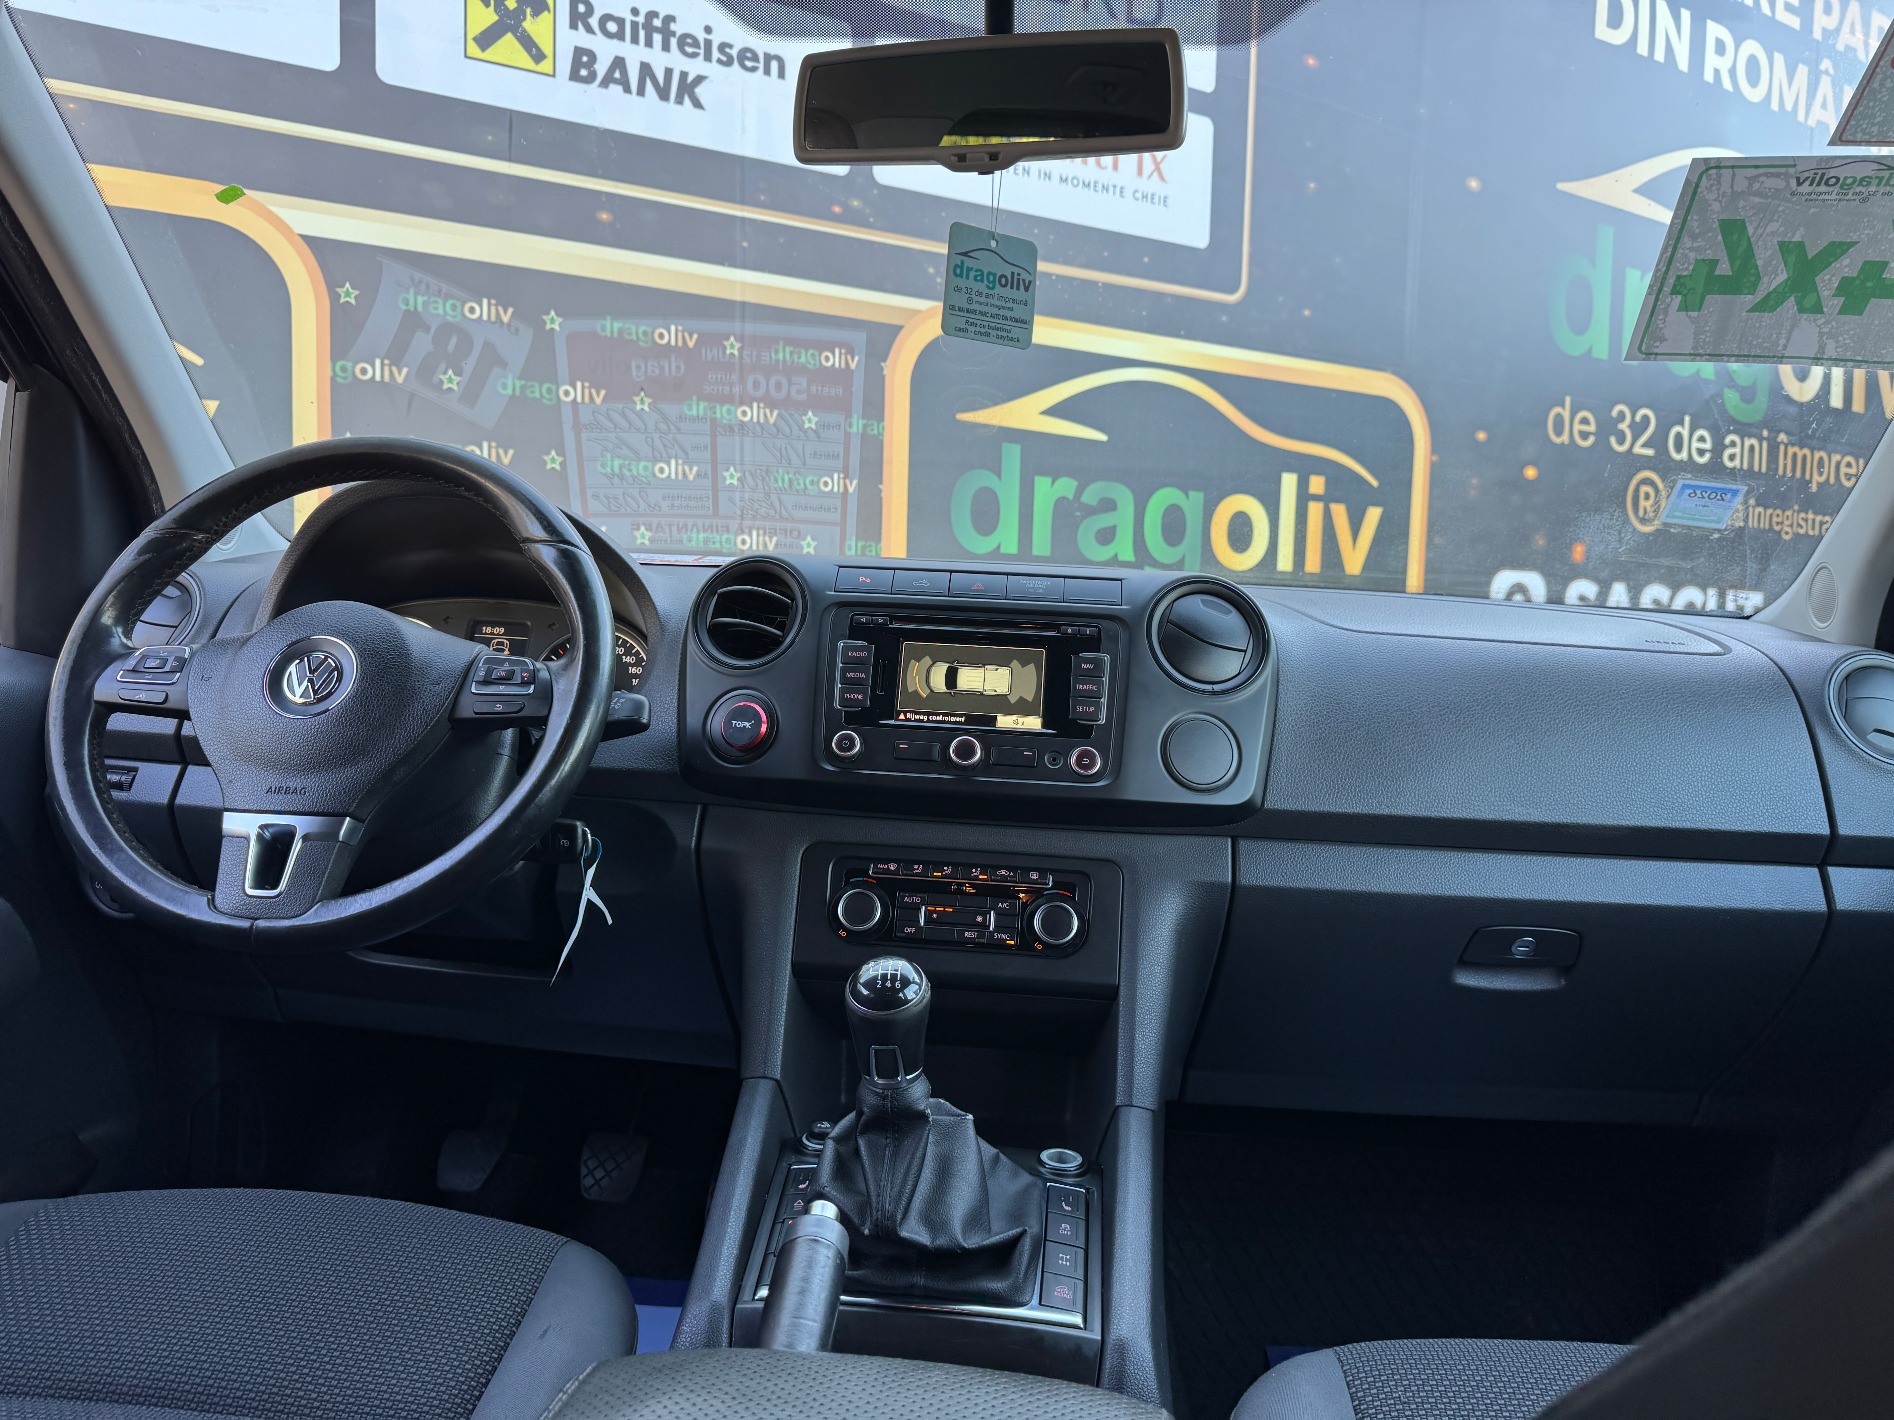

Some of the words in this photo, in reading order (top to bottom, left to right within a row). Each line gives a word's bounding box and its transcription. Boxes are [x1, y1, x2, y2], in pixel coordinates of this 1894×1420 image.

[568, 0, 787, 80] Raiffeisen
[1594, 0, 1690, 73] DIN
[568, 46, 706, 111] BANK
[1038, 168, 1052, 182] IN
[1059, 173, 1126, 199] MOMENTE
[1132, 188, 1170, 208] CHEIE
[952, 260, 1032, 292] dragoliv
[954, 285, 963, 293] de
[964, 287, 973, 296] 32
[975, 289, 983, 297] de
[398, 288, 514, 323] dragoliv
[596, 316, 699, 349] dragoliv
[954, 326, 969, 334] cash
[331, 357, 409, 384] goliv
[771, 341, 860, 371] dragoliv
[497, 373, 607, 405] dragoliv
[683, 395, 779, 425] dragoliv
[1547, 395, 1596, 448] de
[1609, 403, 1657, 457] 32
[1667, 414, 1713, 464] de
[1722, 428, 1769, 474] ani
[596, 451, 699, 482] dragoliv
[771, 468, 858, 494] dragoliv
[951, 442, 1384, 574] dragoliv
[683, 527, 778, 553] dragoliv
[482, 626, 505, 635] 18:09
[628, 666, 643, 674] 160
[906, 712, 928, 721] Rijweg
[266, 785, 307, 797] AIRBAG
[994, 932, 1011, 940] SYNC
[885, 980, 891, 988] 4
